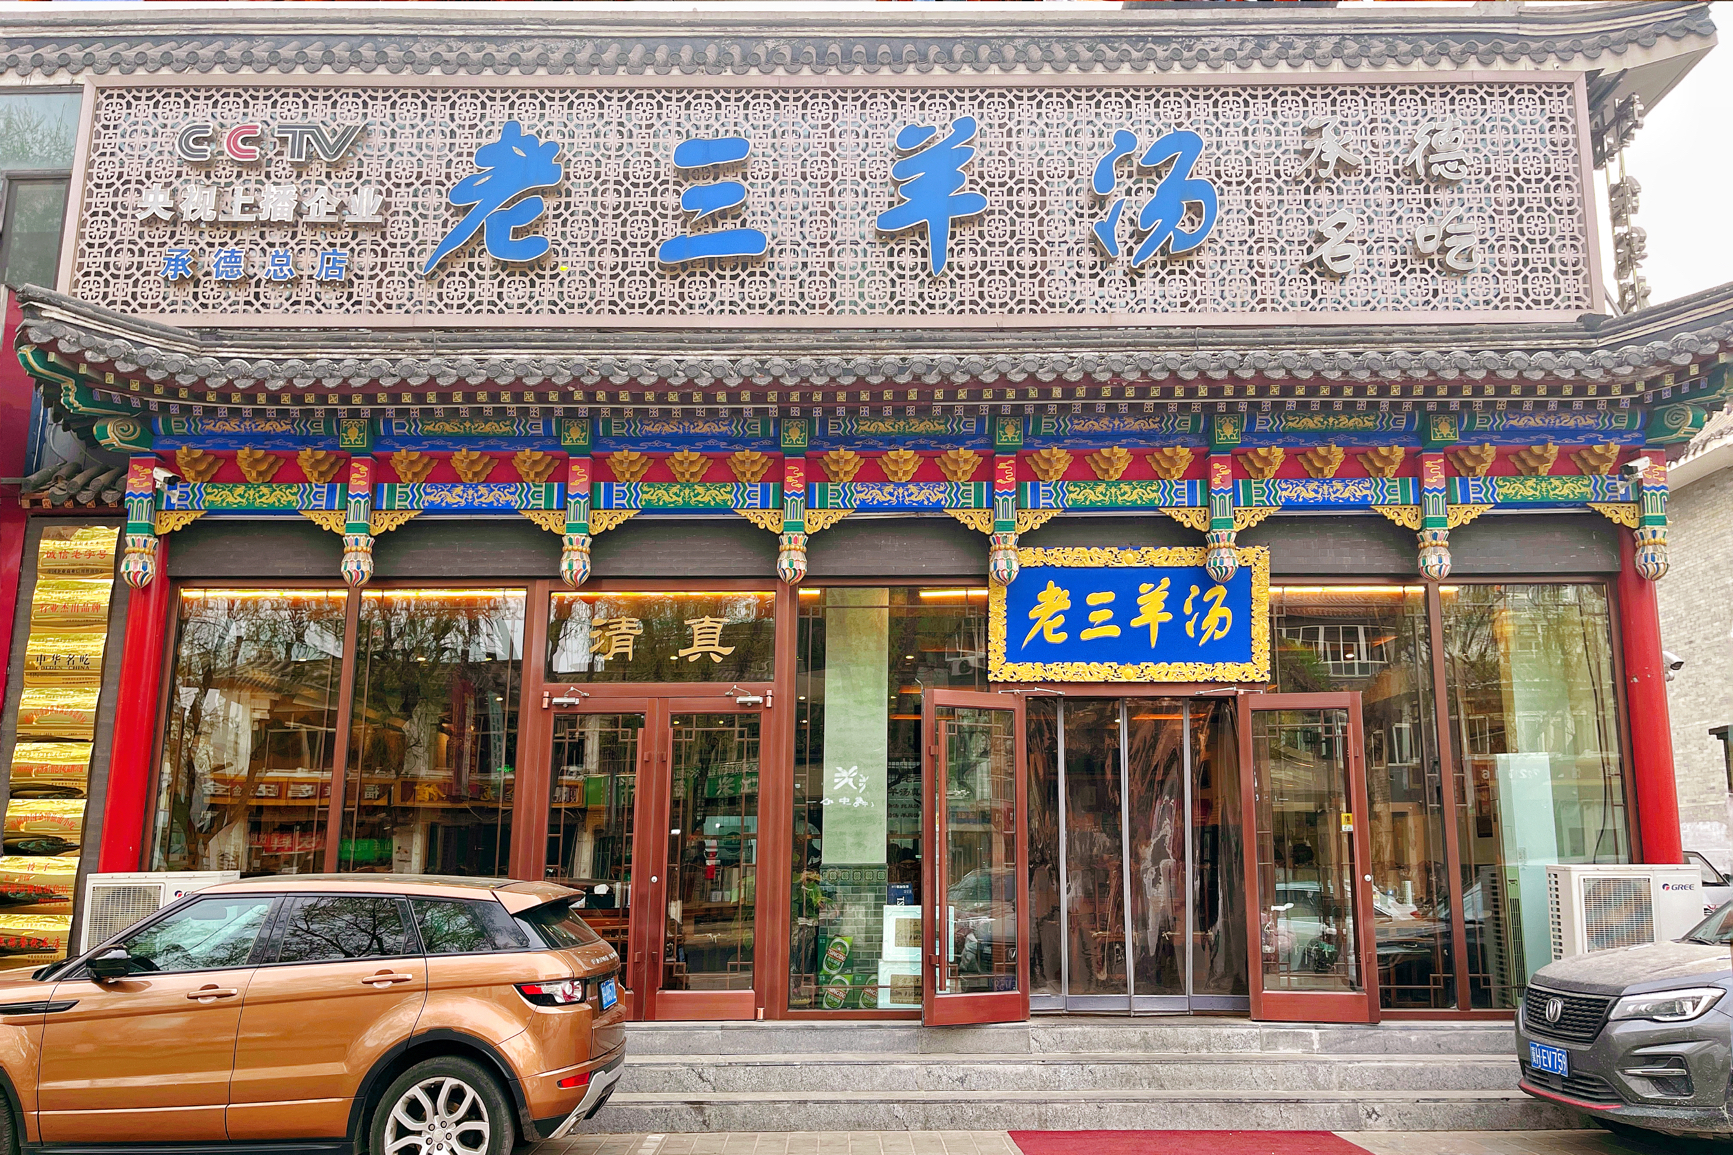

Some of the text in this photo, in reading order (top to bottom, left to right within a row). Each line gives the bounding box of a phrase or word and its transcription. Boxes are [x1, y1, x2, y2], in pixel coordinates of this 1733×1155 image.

[176, 123, 367, 162] CCTV
[1297, 115, 1473, 180] 承德
[135, 183, 385, 223] 央视上播企业
[421, 115, 1220, 277] 老三羊汤
[1305, 207, 1482, 273] 名吃
[158, 247, 349, 281] 承德总店
[1021, 577, 1233, 651] 老三羊汤
[36, 654, 90, 665] 中华名吃
[589, 615, 735, 663] 清真
[1671, 883, 1695, 891] GREE
